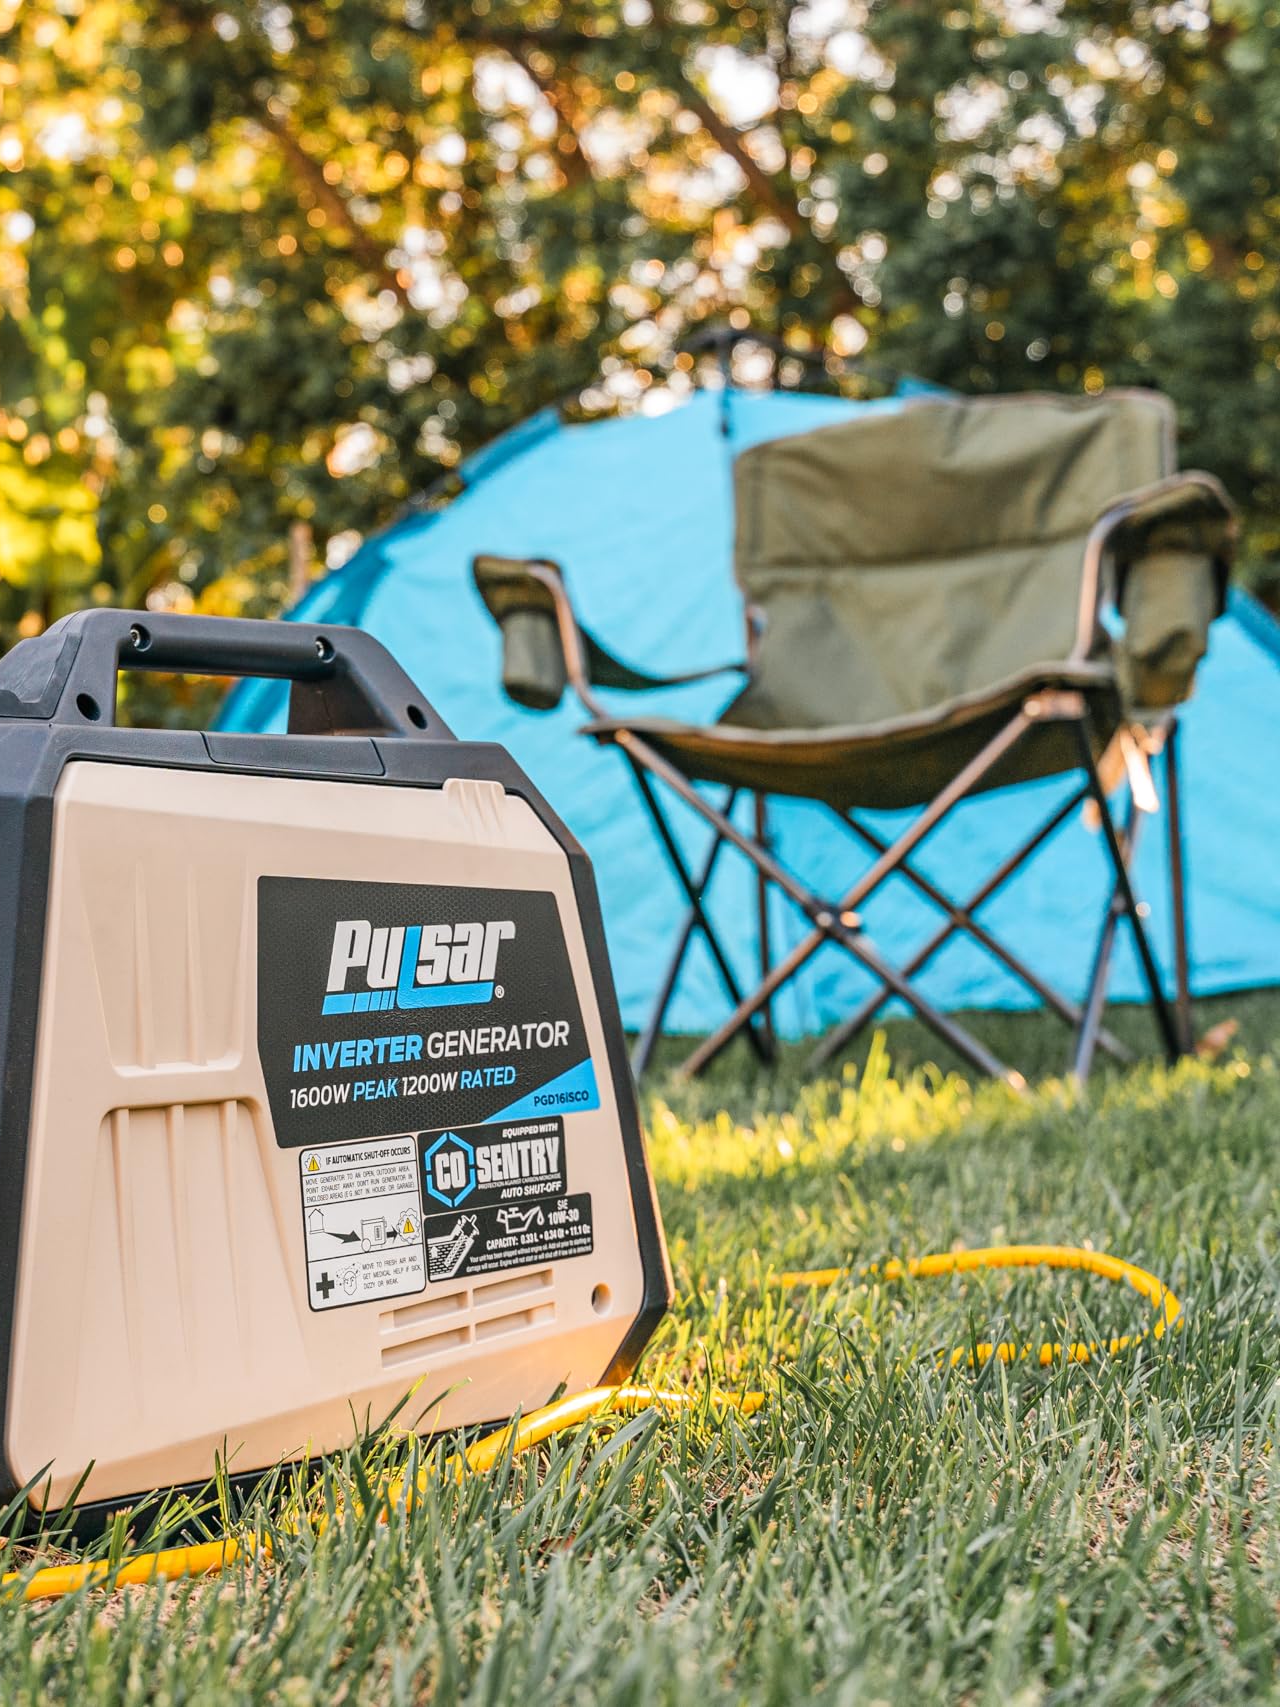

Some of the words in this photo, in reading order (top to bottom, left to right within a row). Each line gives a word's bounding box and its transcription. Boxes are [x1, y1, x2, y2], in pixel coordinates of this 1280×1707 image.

[323, 920, 516, 1011] Pulsar
[293, 1034, 422, 1073] INVERTER
[427, 1021, 570, 1059] GENERATOR
[290, 1083, 351, 1109] 1600W
[353, 1078, 398, 1101] PEAK
[402, 1071, 458, 1096] 1200W
[460, 1066, 517, 1090] RATED
[502, 1125, 538, 1139] EQUIPPED
[539, 1123, 559, 1133] WITH
[332, 1152, 363, 1164] AUTOMATIC
[363, 1149, 390, 1160] SHUT-OFF
[390, 1146, 411, 1156] OCCURS
[434, 1151, 467, 1190] CO
[475, 1137, 560, 1183] SENTRY
[320, 1174, 345, 1183] GENERATOR
[500, 1186, 523, 1199] AUTO
[523, 1180, 562, 1196] SHUT-OFF
[547, 1209, 579, 1226] 10W-30
[486, 1236, 519, 1250] CAPACITY:
[520, 1233, 534, 1245] 0.33
[544, 1229, 557, 1241] 0.34
